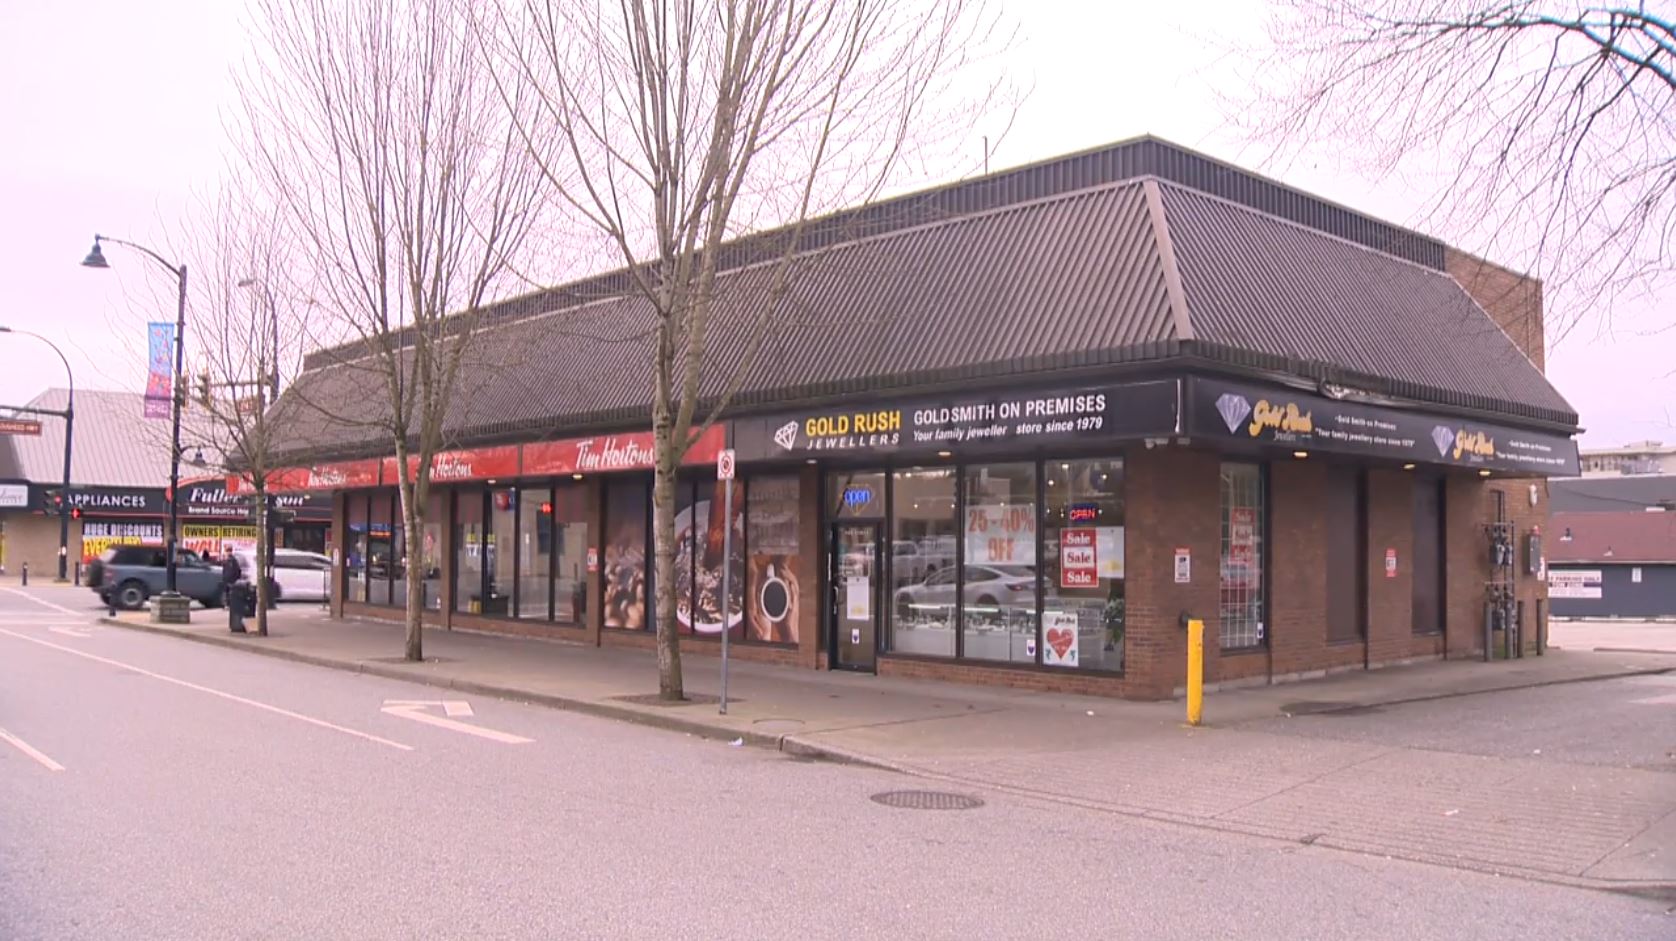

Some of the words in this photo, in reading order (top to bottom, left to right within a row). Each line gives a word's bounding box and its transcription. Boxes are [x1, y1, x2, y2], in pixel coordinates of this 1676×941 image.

[914, 404, 995, 426] GOLDSMITH
[1000, 401, 1020, 419] ON
[1026, 394, 1106, 416] PREMISES
[806, 415, 849, 437] GOLD
[854, 411, 900, 433] RUSH
[914, 429, 932, 441] Your
[935, 427, 965, 442] family
[966, 424, 1008, 440] jeweller
[1016, 422, 1042, 434] store
[1045, 420, 1074, 433] since
[1077, 416, 1103, 430] 1979
[576, 441, 600, 469] Tim
[601, 437, 654, 467] Hortons
[806, 433, 900, 450] JEWELLERS
[184, 526, 219, 537] OWNERS
[969, 509, 988, 533] 25
[1000, 507, 1034, 533] 40%
[987, 538, 1015, 561] OFF
[1067, 533, 1091, 545] Sale
[1067, 551, 1091, 564] Sale
[1067, 571, 1091, 583] Sale
